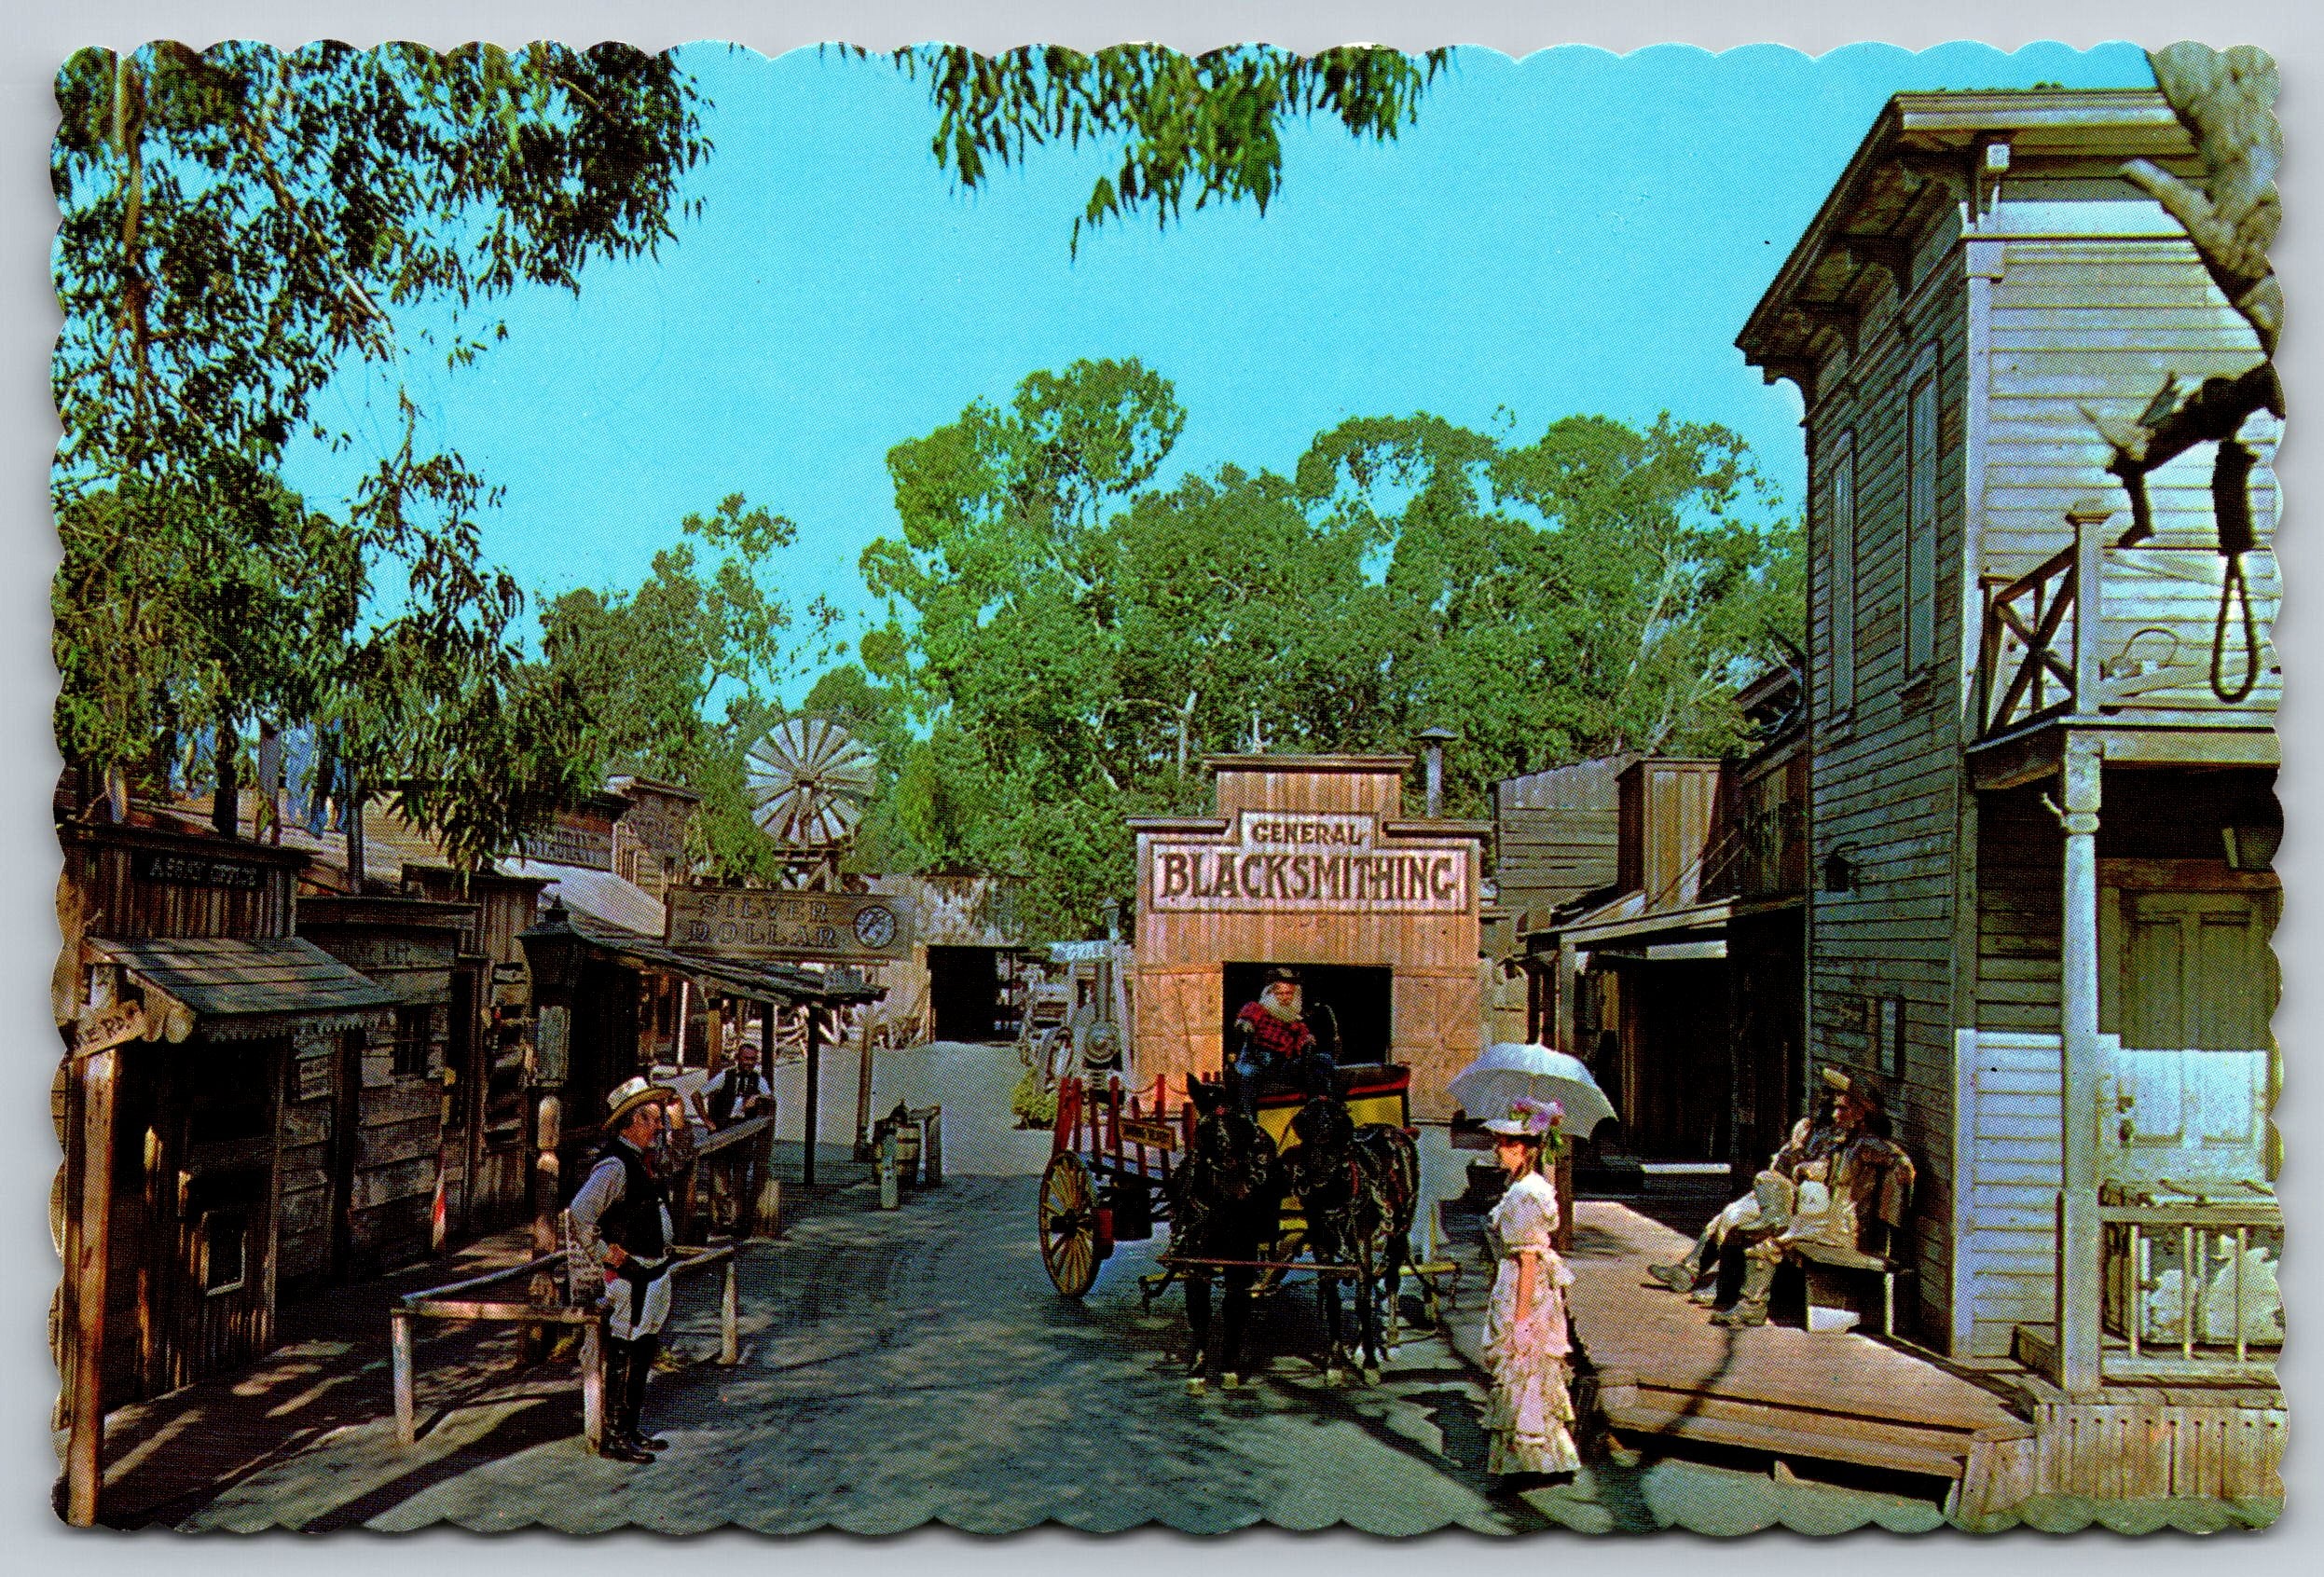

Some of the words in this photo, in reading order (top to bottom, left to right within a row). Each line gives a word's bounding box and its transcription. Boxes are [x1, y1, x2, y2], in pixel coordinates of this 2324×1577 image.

[1251, 823, 1367, 846] GENERAL
[1161, 853, 1457, 903] BLACKSMITHING
[698, 894, 830, 924] SILVER
[687, 919, 838, 949] DOLLAR
